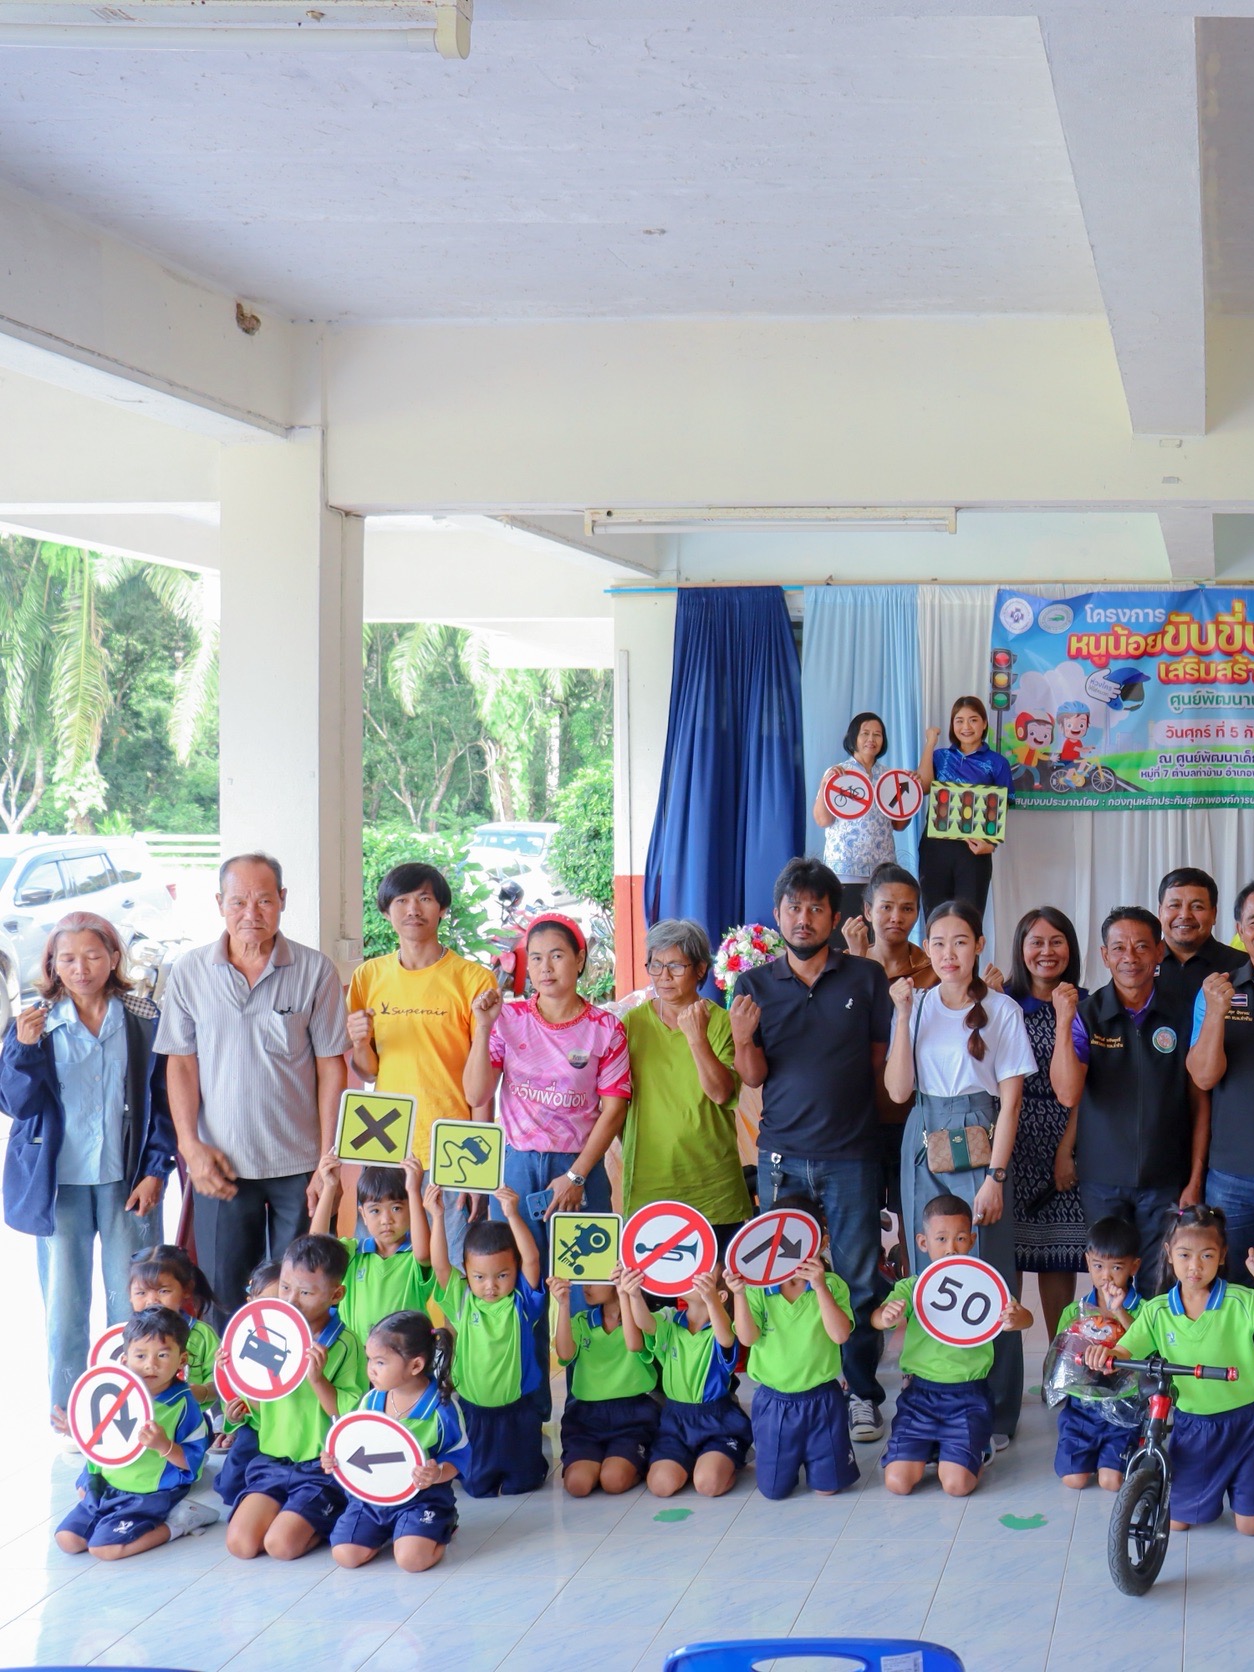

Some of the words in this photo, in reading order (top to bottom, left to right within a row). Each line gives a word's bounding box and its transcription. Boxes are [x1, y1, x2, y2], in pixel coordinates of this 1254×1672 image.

[1085, 605, 1166, 623] โครงการ
[1165, 723, 1211, 742] วันศุกร์
[1215, 721, 1225, 739] ที่
[1230, 727, 1239, 739] 5
[1159, 754, 1172, 764] ณ
[1140, 767, 1160, 780] หมู่ที่
[1163, 769, 1169, 778] 7
[1172, 767, 1222, 778] ตำบลท่าข้าม
[1015, 796, 1099, 809] สนุนงบประมาณโดย
[391, 1006, 448, 1016] Superair
[930, 1276, 991, 1325] 50
